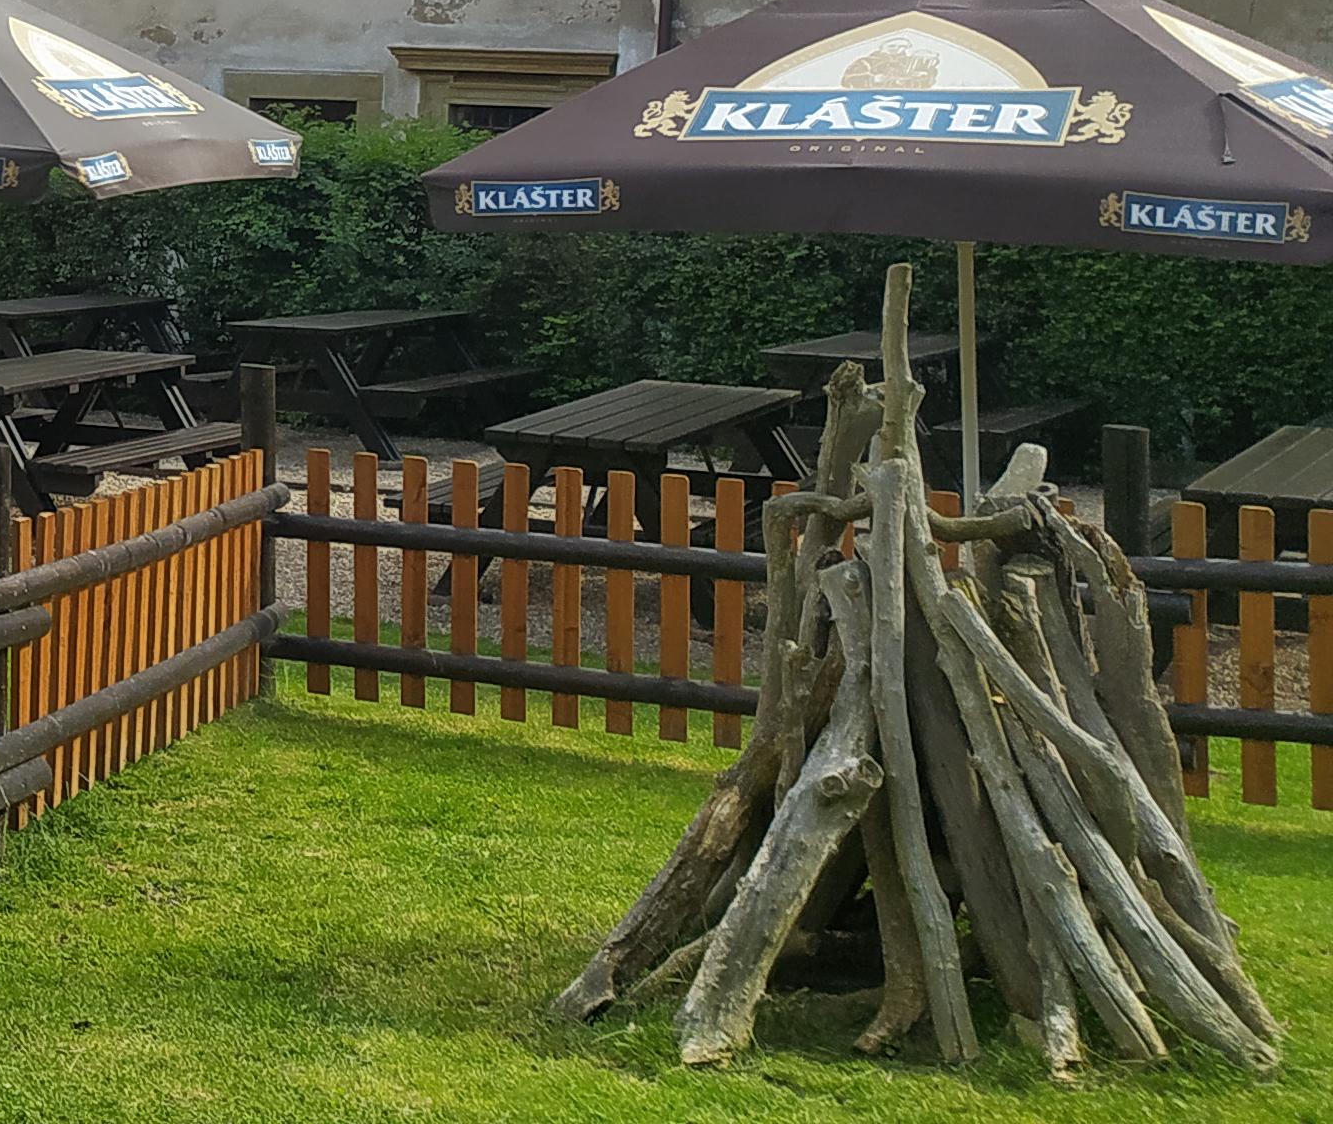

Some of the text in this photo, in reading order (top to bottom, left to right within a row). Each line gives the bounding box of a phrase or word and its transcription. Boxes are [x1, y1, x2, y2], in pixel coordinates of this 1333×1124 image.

[701, 95, 1050, 136] KLÁŠTER
[789, 143, 925, 154] ORIGINAL
[478, 186, 596, 210] KLÁŠTER
[1130, 204, 1277, 236] KLÁŠTER
